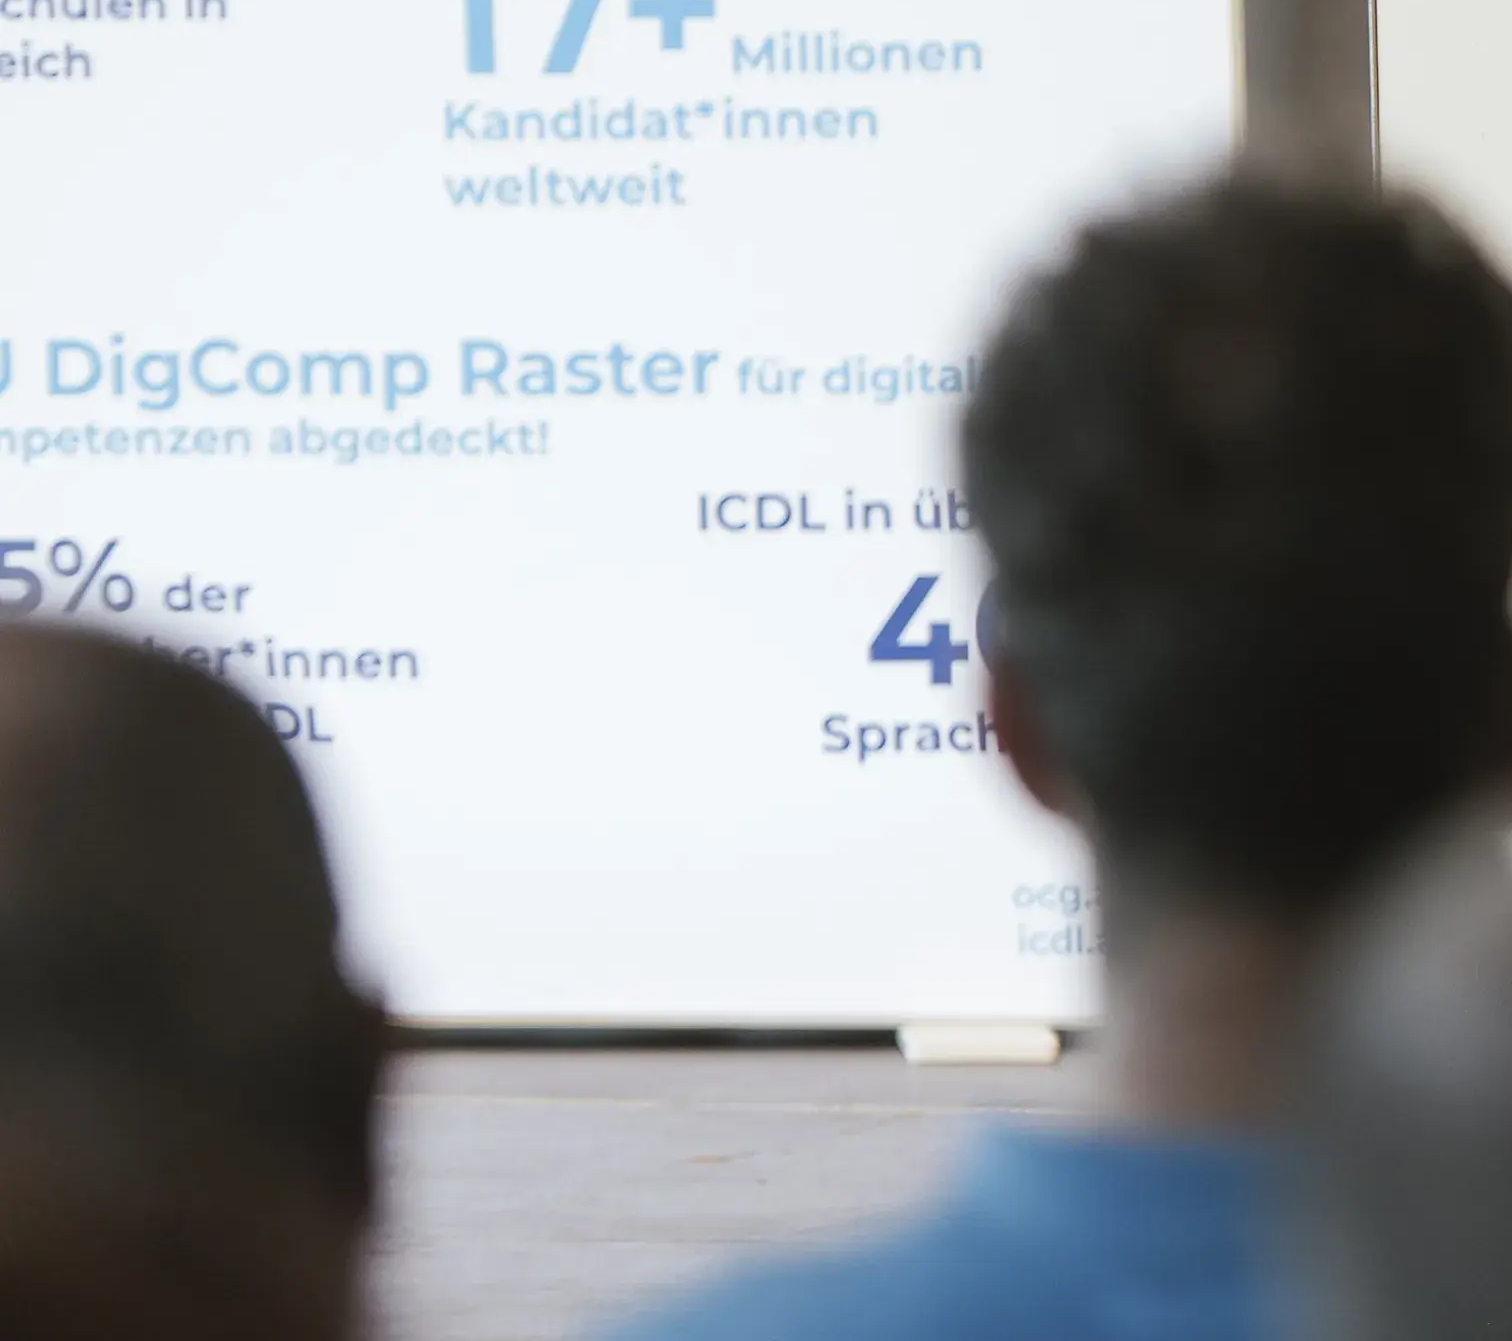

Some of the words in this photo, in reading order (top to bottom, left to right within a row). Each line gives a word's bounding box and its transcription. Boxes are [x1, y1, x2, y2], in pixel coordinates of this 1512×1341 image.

[731, 32, 985, 76] Millionen
[444, 165, 687, 208] weltweit
[46, 331, 431, 412] DigComp
[459, 338, 721, 398] Raster
[737, 354, 806, 396] für
[269, 418, 550, 465] abgedeckt!
[698, 493, 827, 532] ICDL
[845, 488, 893, 531] in
[163, 573, 252, 613] der
[821, 711, 1007, 765] Sprach
